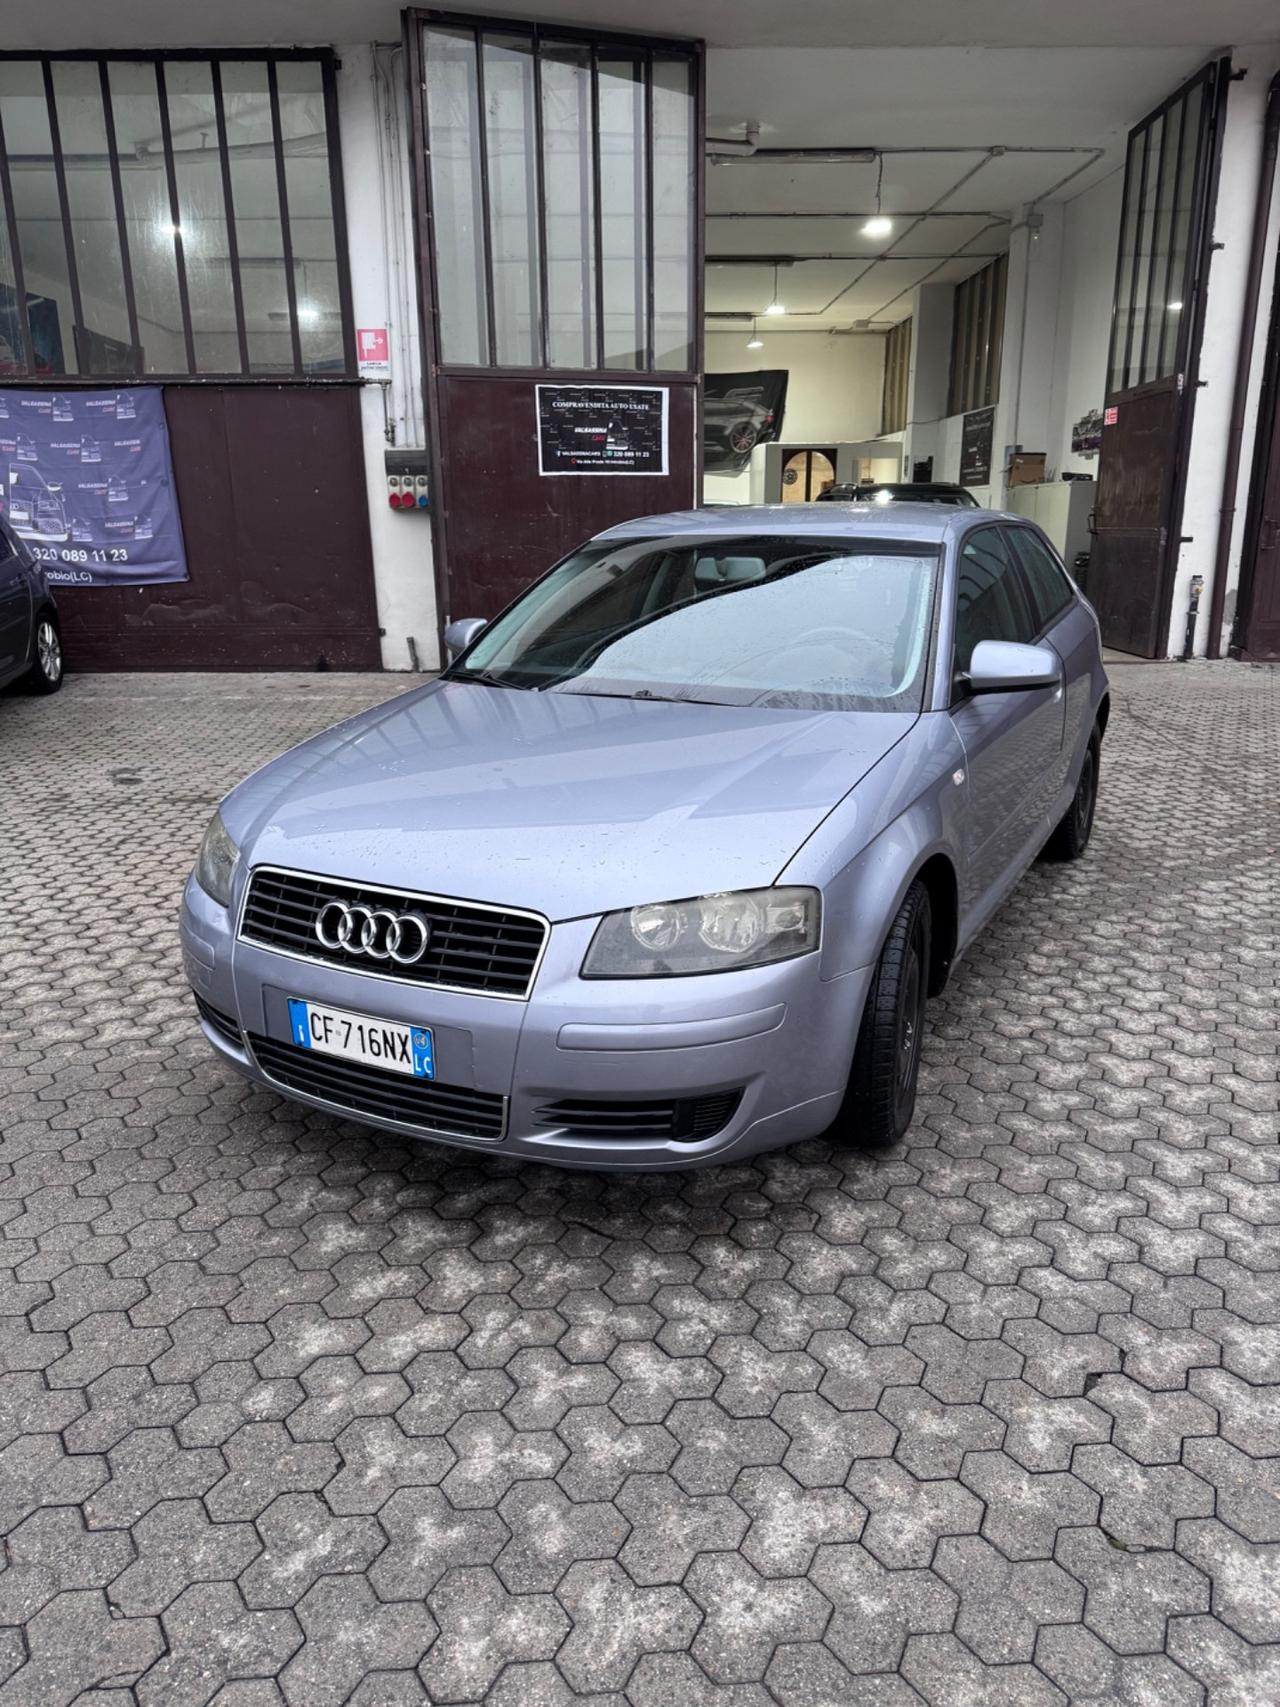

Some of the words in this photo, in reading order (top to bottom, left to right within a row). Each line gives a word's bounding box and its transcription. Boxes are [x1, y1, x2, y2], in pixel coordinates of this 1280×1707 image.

[552, 401, 610, 409] COMPRAVENDITA
[610, 402, 628, 410] AUTO
[629, 402, 650, 411] USATE
[33, 547, 58, 561] 320
[62, 549, 88, 562] 089
[92, 550, 107, 562] 11
[111, 549, 128, 562] 23
[414, 1054, 432, 1074] LC
